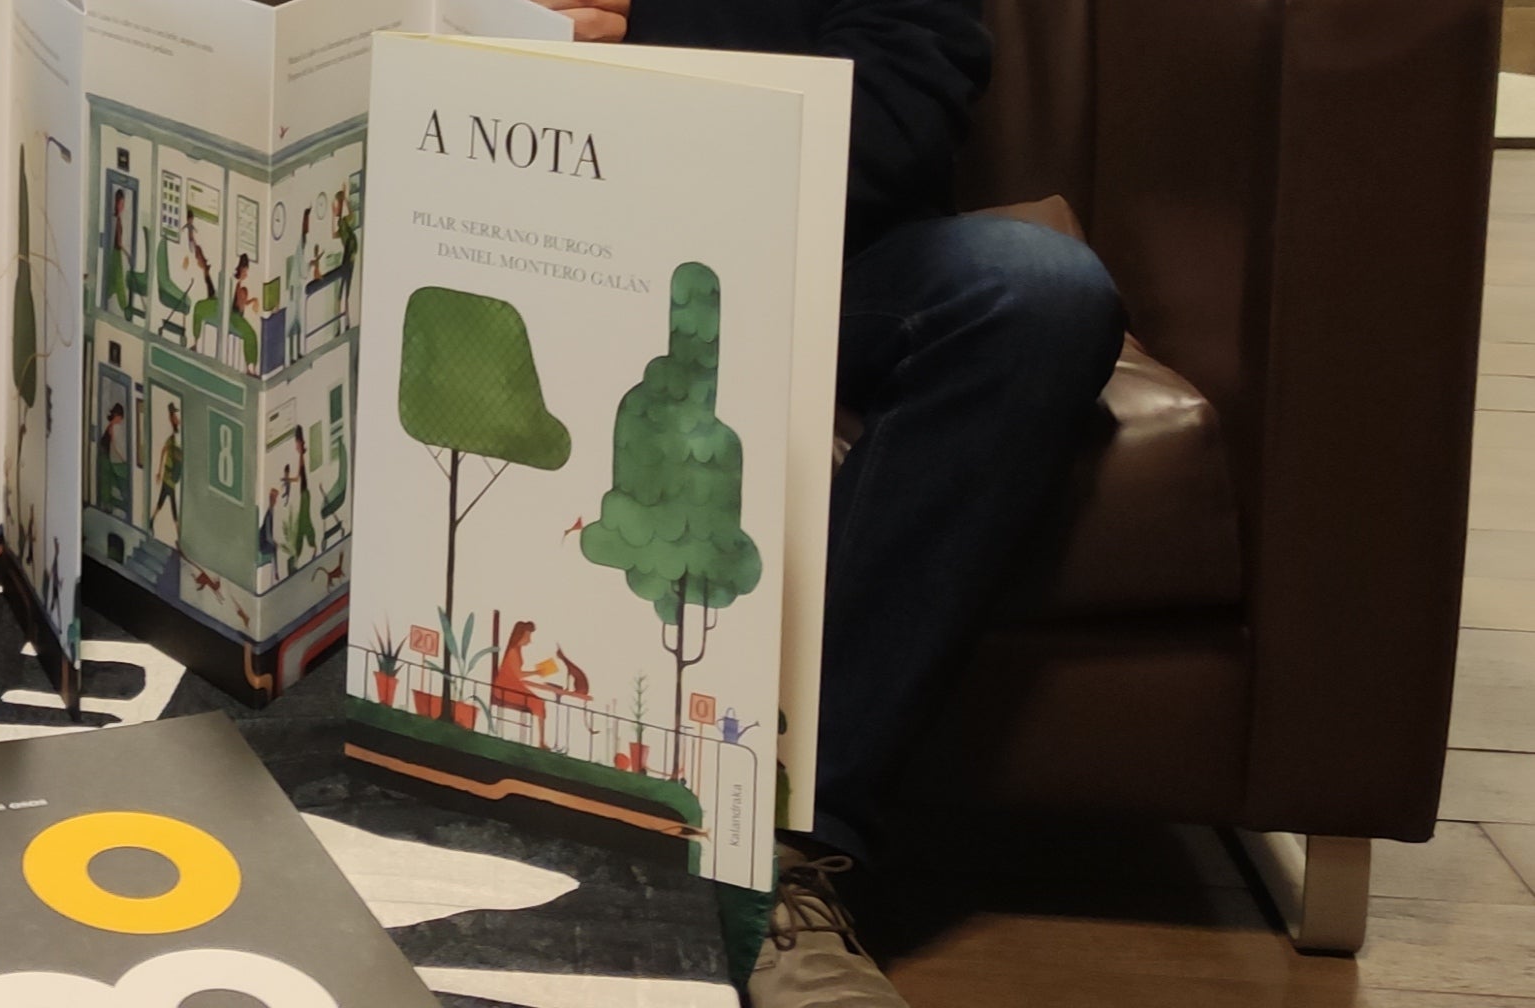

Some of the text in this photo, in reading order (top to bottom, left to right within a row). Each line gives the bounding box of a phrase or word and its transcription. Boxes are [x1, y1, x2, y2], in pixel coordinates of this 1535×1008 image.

[416, 109, 606, 181] A NOTA
[412, 210, 613, 259] PILAR SERRANO BURGOS
[437, 242, 651, 294] DANIEL MONTERO GALÁN
[9, 797, 48, 811] osos
